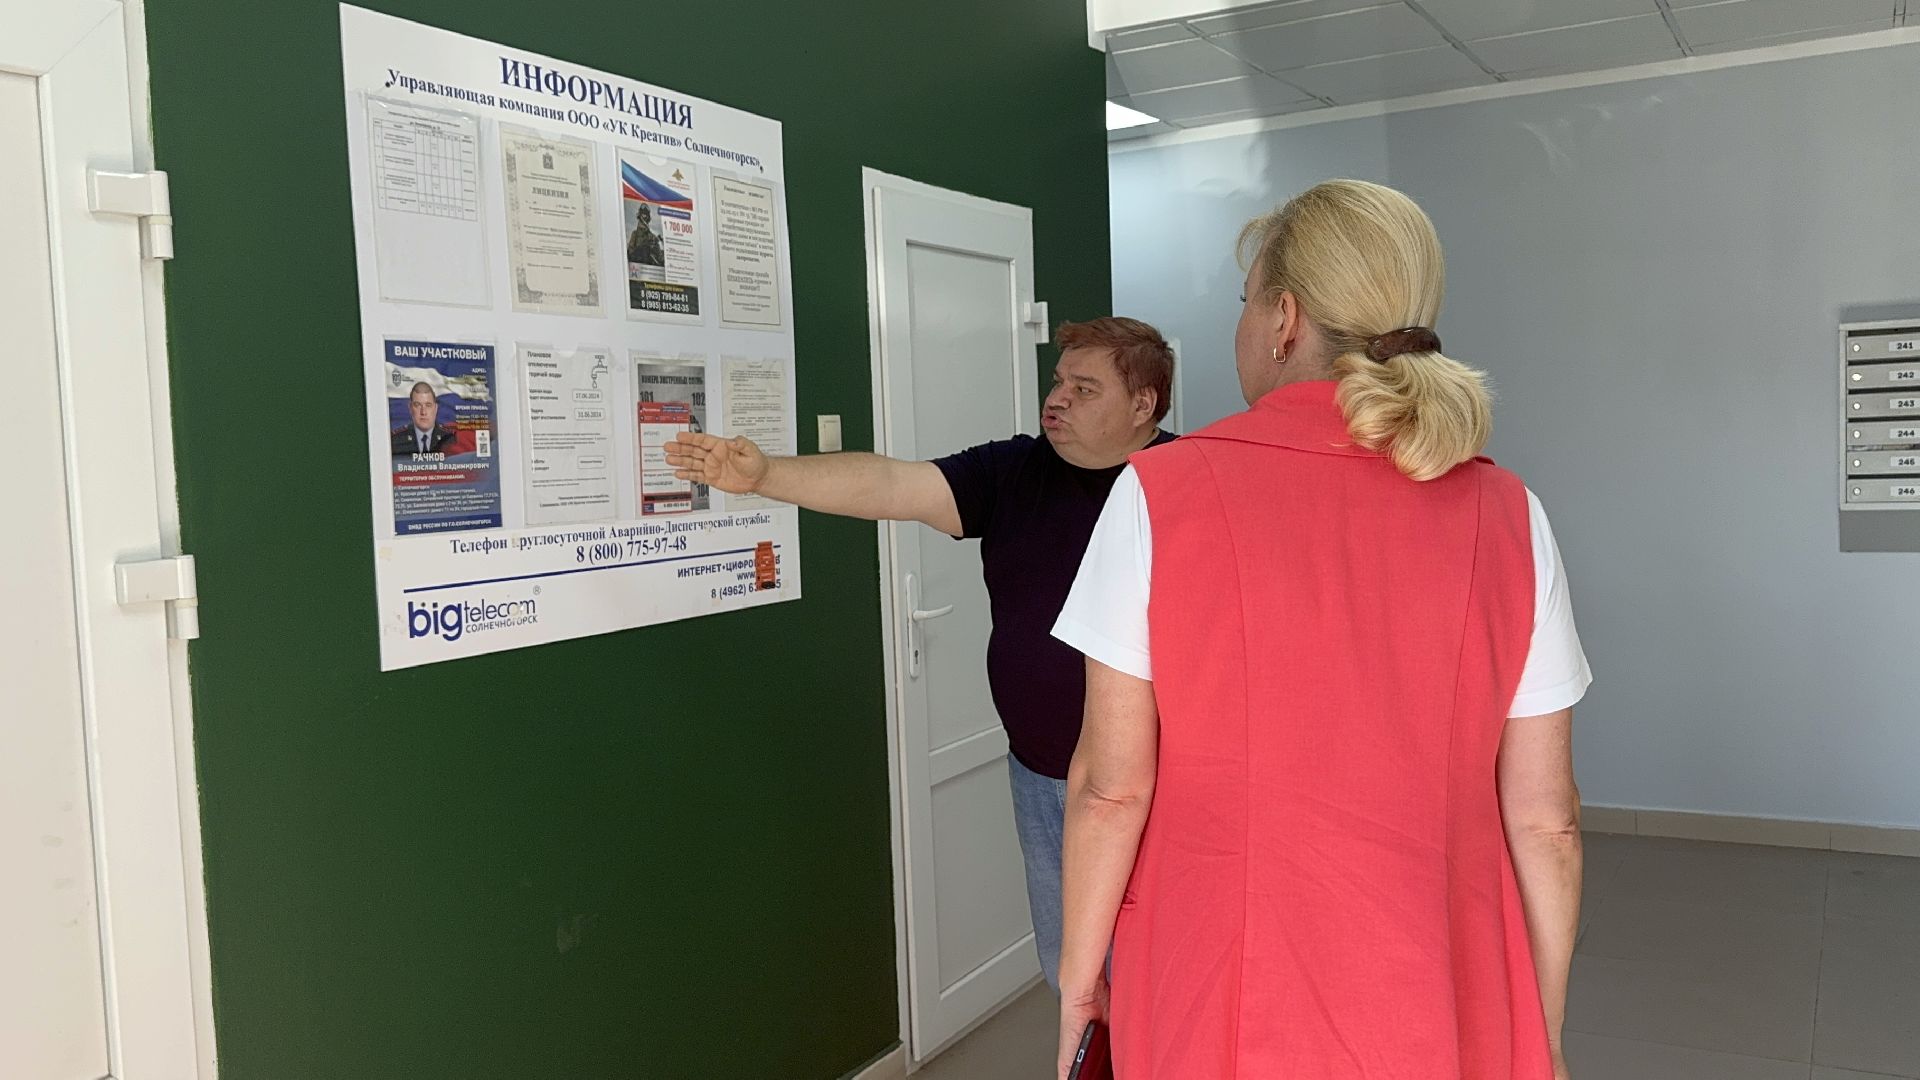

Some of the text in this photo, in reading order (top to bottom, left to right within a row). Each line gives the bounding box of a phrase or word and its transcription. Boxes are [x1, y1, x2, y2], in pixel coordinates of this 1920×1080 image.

[499, 56, 694, 130] ИНФОРМАЦИЯ
[388, 68, 496, 107] Управляющая
[500, 97, 565, 122] компания
[568, 108, 600, 130] ООО
[631, 124, 682, 148] Креатив»
[1896, 342, 1914, 350] 241
[394, 345, 487, 360] ВАШ УЧАСТКОВЫЙ
[1897, 371, 1915, 379] 242
[640, 390, 654, 403] 101
[692, 391, 706, 406] 102
[1897, 400, 1915, 408] 243
[1897, 429, 1915, 437] 244
[412, 452, 445, 462] РАЧКОВ
[1898, 458, 1916, 466] 245
[398, 462, 490, 472] Владислав Владимирович
[1898, 487, 1916, 495] 246
[450, 537, 507, 555] Телефон
[512, 527, 606, 550] руглосуточной
[735, 512, 771, 528] службы:
[576, 535, 687, 565] 8 (800) 775-97-48
[711, 588, 716, 599] 8
[719, 583, 747, 600] (4962)
